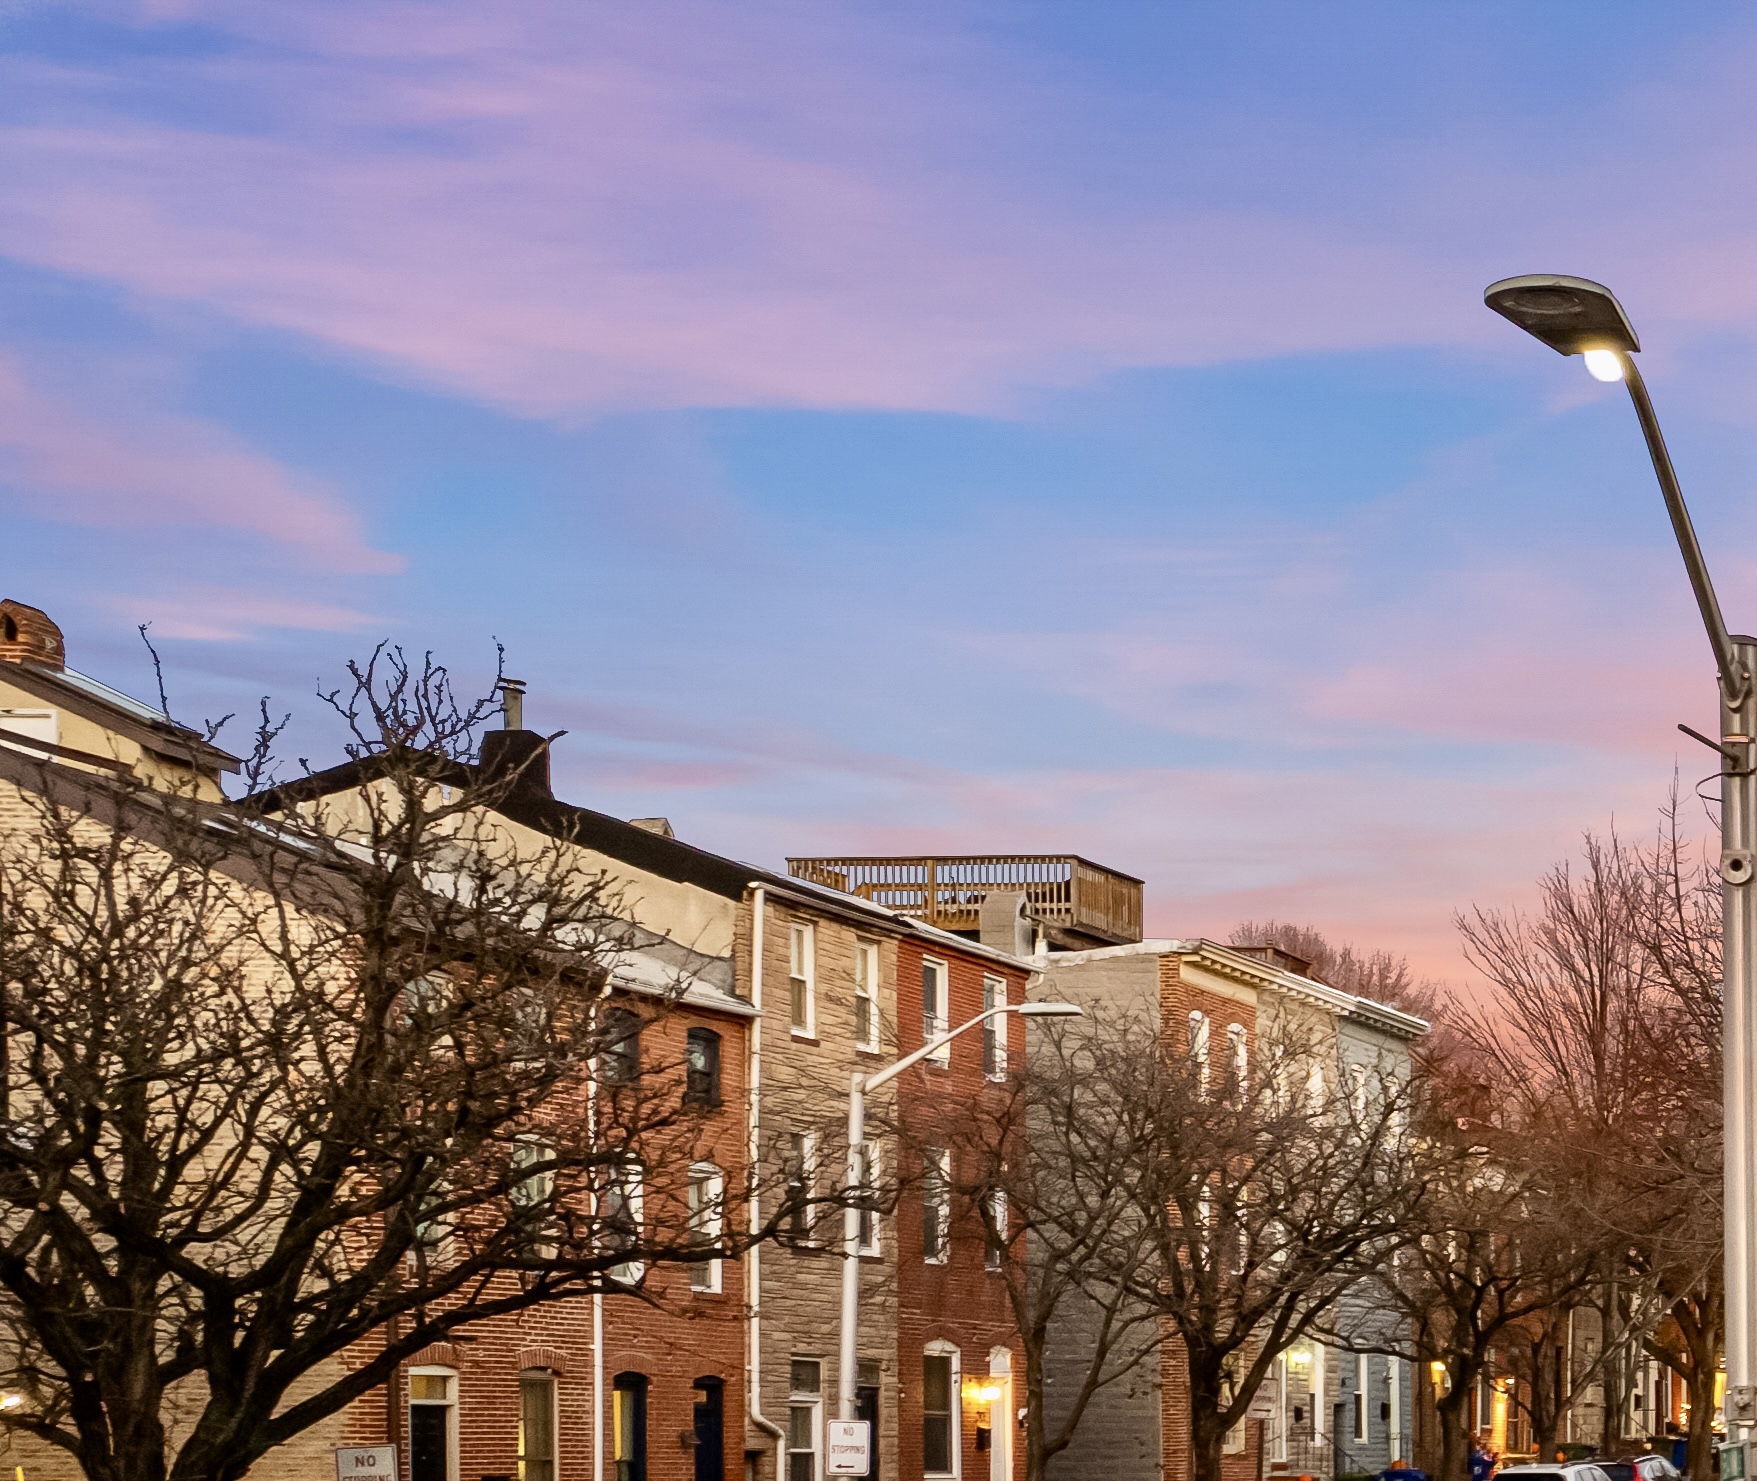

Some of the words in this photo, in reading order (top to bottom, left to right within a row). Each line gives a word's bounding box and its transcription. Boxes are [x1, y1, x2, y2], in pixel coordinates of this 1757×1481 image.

[843, 1427, 854, 1436] NO
[831, 1445, 865, 1455] STOPPING
[354, 1455, 376, 1467] NO
